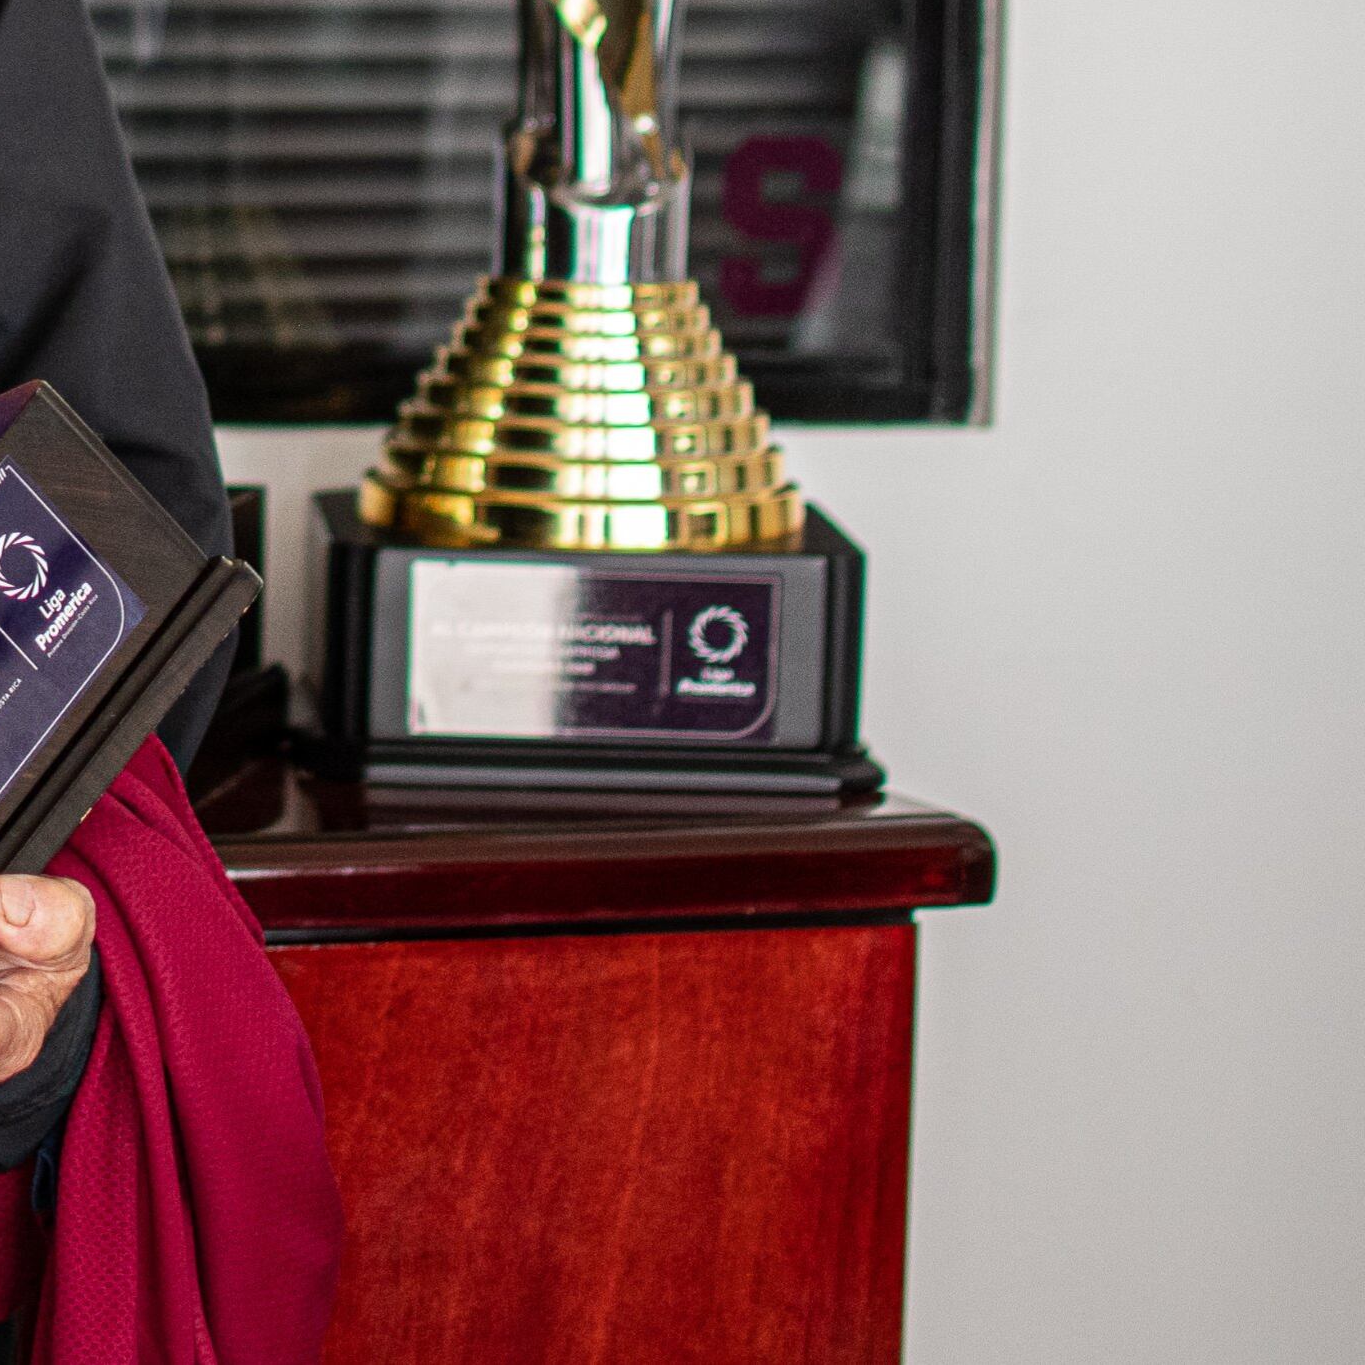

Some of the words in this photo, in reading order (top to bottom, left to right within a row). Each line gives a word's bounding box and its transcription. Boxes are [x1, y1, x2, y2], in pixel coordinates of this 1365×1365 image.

[34, 582, 92, 651] Promerica
[38, 588, 66, 618] Liga
[8, 678, 21, 693] RICA
